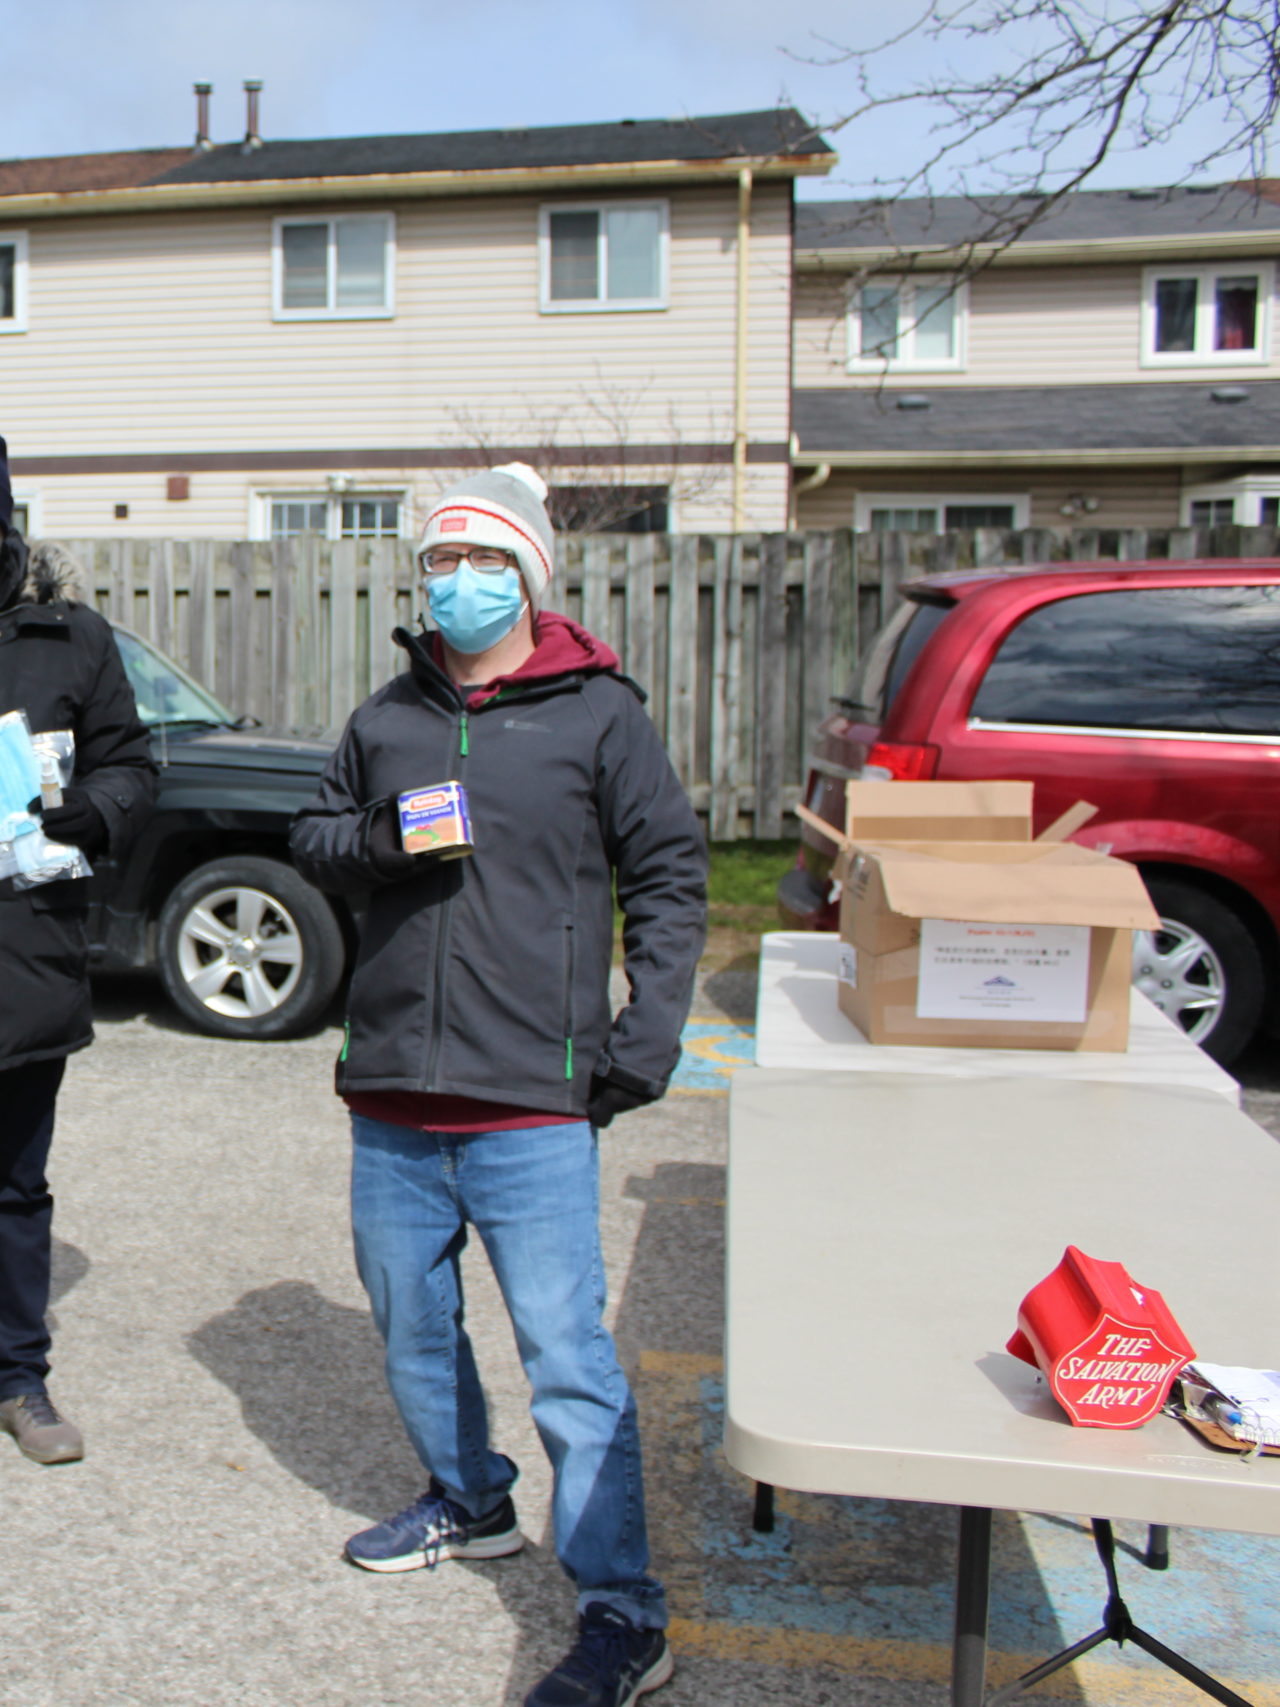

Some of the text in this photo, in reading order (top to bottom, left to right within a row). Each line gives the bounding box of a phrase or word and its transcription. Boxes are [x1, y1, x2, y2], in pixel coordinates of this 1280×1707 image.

[1097, 1333, 1152, 1356] THE
[1058, 1357, 1176, 1383] SALVATION
[1076, 1384, 1157, 1409] ARMY
